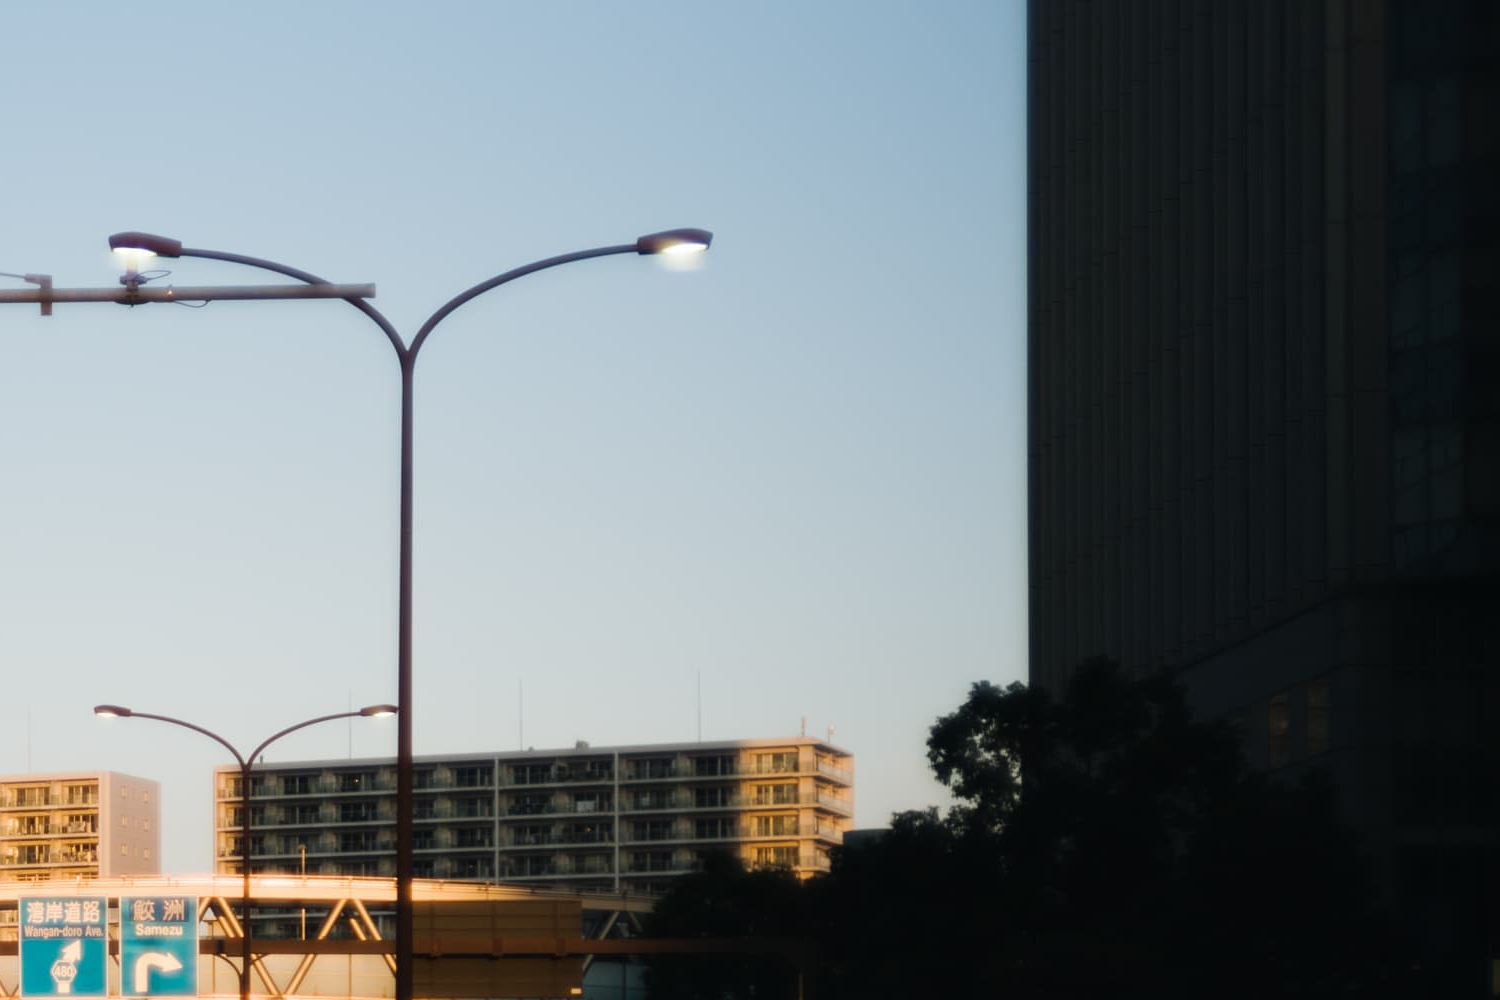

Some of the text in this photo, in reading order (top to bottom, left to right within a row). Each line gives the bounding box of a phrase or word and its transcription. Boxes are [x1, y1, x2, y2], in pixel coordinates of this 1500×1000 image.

[27, 901, 100, 924] 湾岸道路
[133, 899, 185, 921] 鮫洲
[24, 926, 104, 940] Wangan-doro Ave.
[135, 923, 184, 937] Samezu
[53, 965, 73, 978] 480
